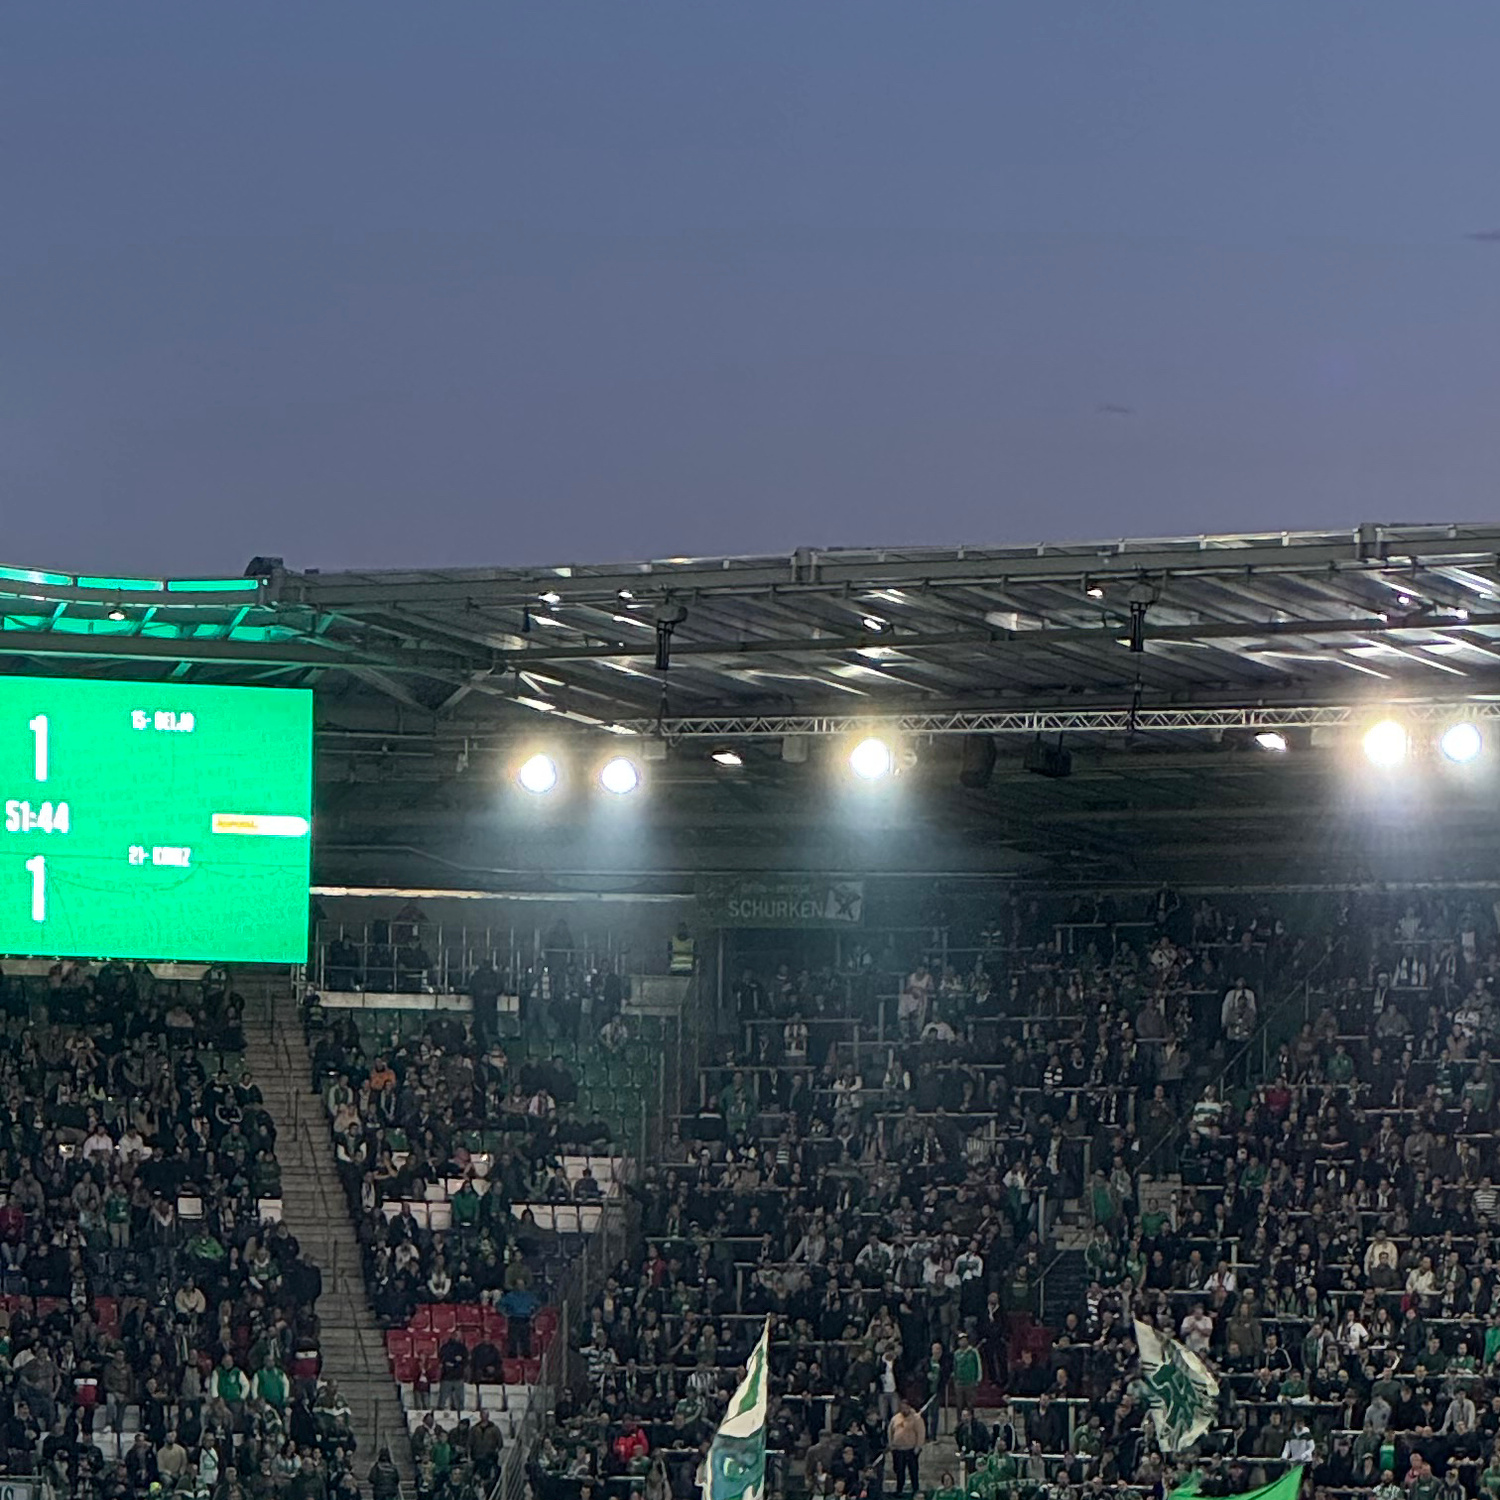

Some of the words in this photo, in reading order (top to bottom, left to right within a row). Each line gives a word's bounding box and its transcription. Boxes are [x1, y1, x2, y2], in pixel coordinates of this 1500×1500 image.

[29, 714, 48, 782] 1
[5, 800, 69, 833] 51:44
[26, 855, 45, 922] 1
[728, 901, 825, 918] SCHURKEN
